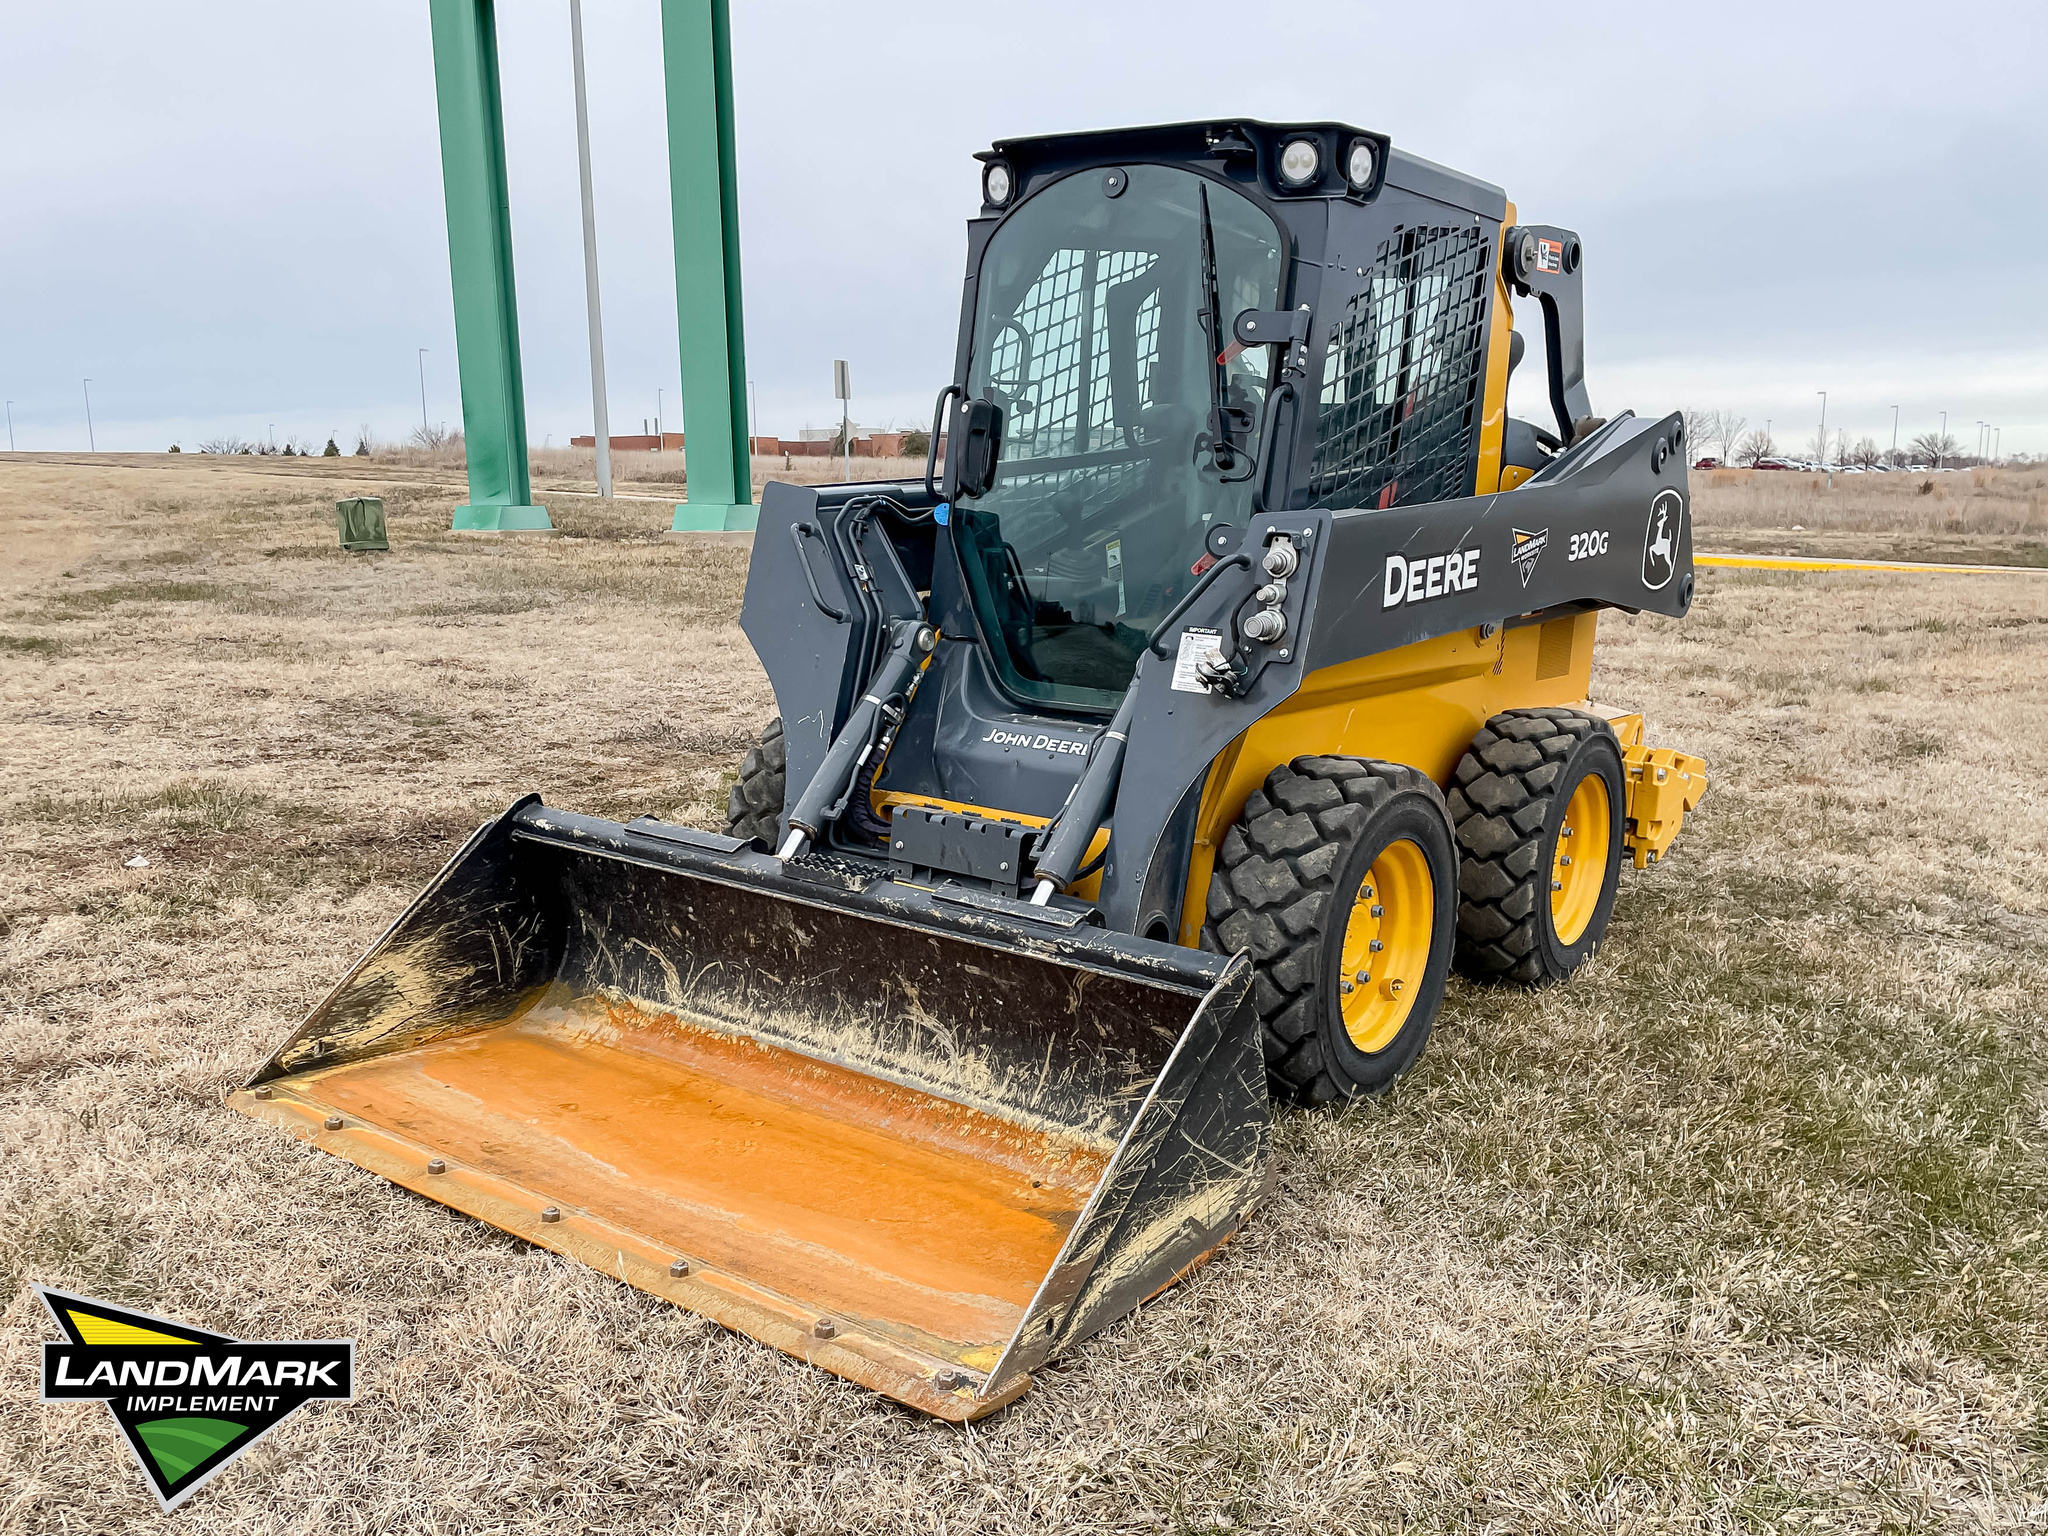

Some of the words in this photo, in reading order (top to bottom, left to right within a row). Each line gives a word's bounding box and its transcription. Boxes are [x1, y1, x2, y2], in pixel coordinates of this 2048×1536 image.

[1568, 530, 1610, 562] 320G
[1383, 549, 1481, 608] DEERE
[1188, 626, 1218, 635] IMPORTANT
[982, 728, 1033, 748] JOHN
